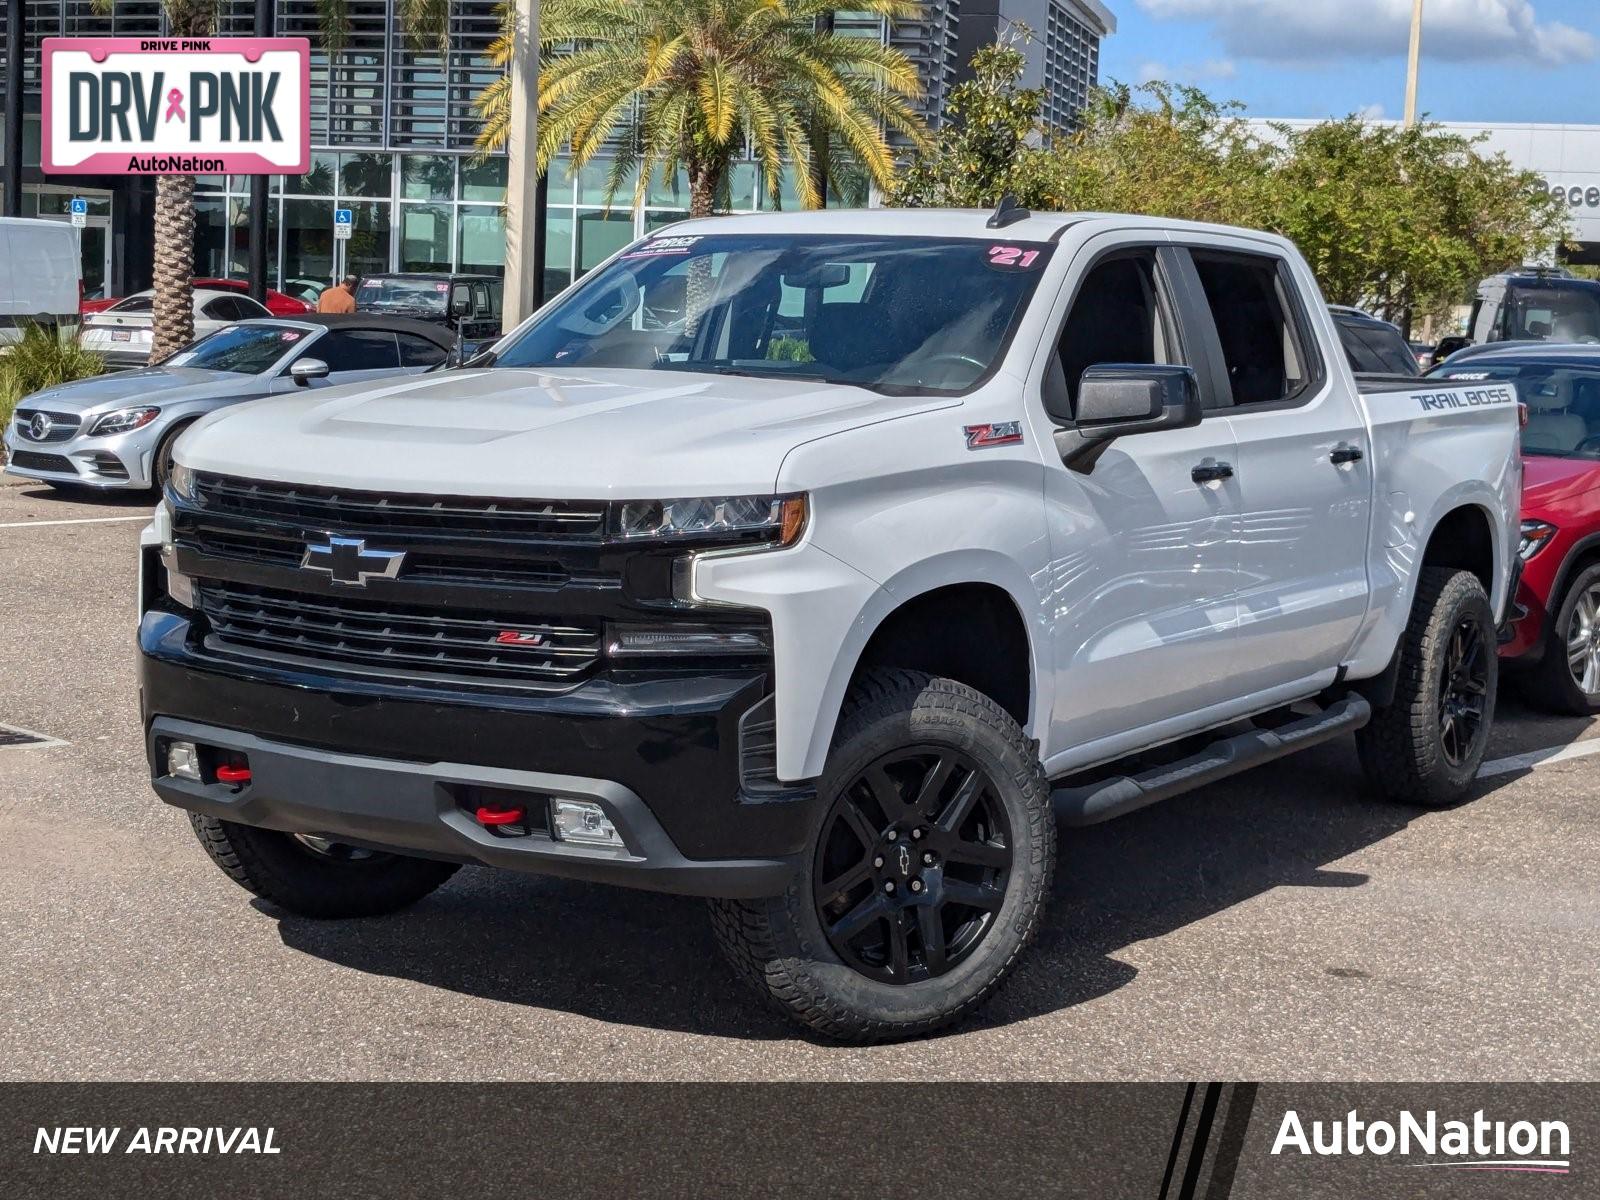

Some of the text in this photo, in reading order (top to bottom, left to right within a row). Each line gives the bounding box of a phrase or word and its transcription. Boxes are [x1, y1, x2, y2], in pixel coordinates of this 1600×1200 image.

[989, 246, 1040, 267] '21
[1410, 388, 1512, 411] TRAIL BOSS
[963, 421, 1024, 450] Z71
[496, 630, 542, 645] Z71
